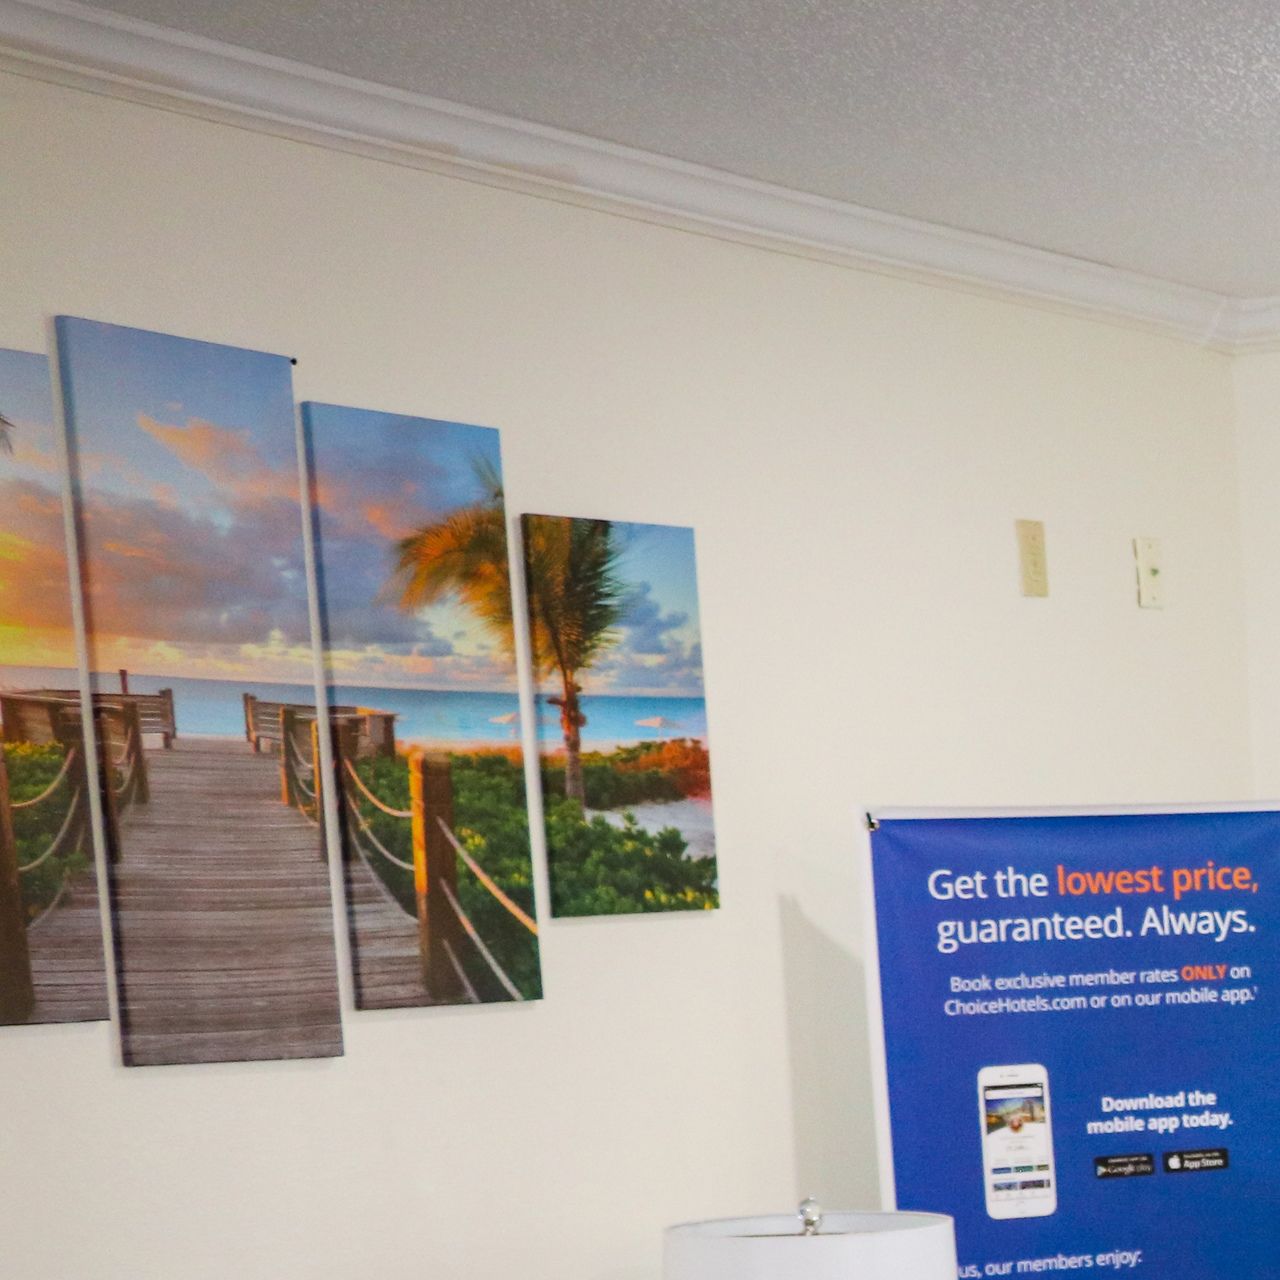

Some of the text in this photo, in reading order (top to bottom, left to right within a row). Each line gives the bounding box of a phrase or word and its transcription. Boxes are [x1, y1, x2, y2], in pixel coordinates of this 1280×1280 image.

[928, 861, 1259, 900] Get the lowest price,
[937, 905, 1256, 953] guaranteed. Always.
[950, 964, 1251, 992] Book exclusive member rates ONLY on
[944, 995, 1088, 1016] ChoiceHotels.com
[1091, 995, 1107, 1009] or
[1111, 994, 1132, 1007] on
[1135, 993, 1162, 1006] our
[1165, 987, 1218, 1004] mobile
[1101, 1090, 1217, 1112] Download the
[1087, 1111, 1233, 1134] mobile app today.
[1201, 1158, 1223, 1167] Store
[985, 1262, 1013, 1276] our
[1017, 1254, 1093, 1273] members
[1096, 1250, 1143, 1269] enjoy:
